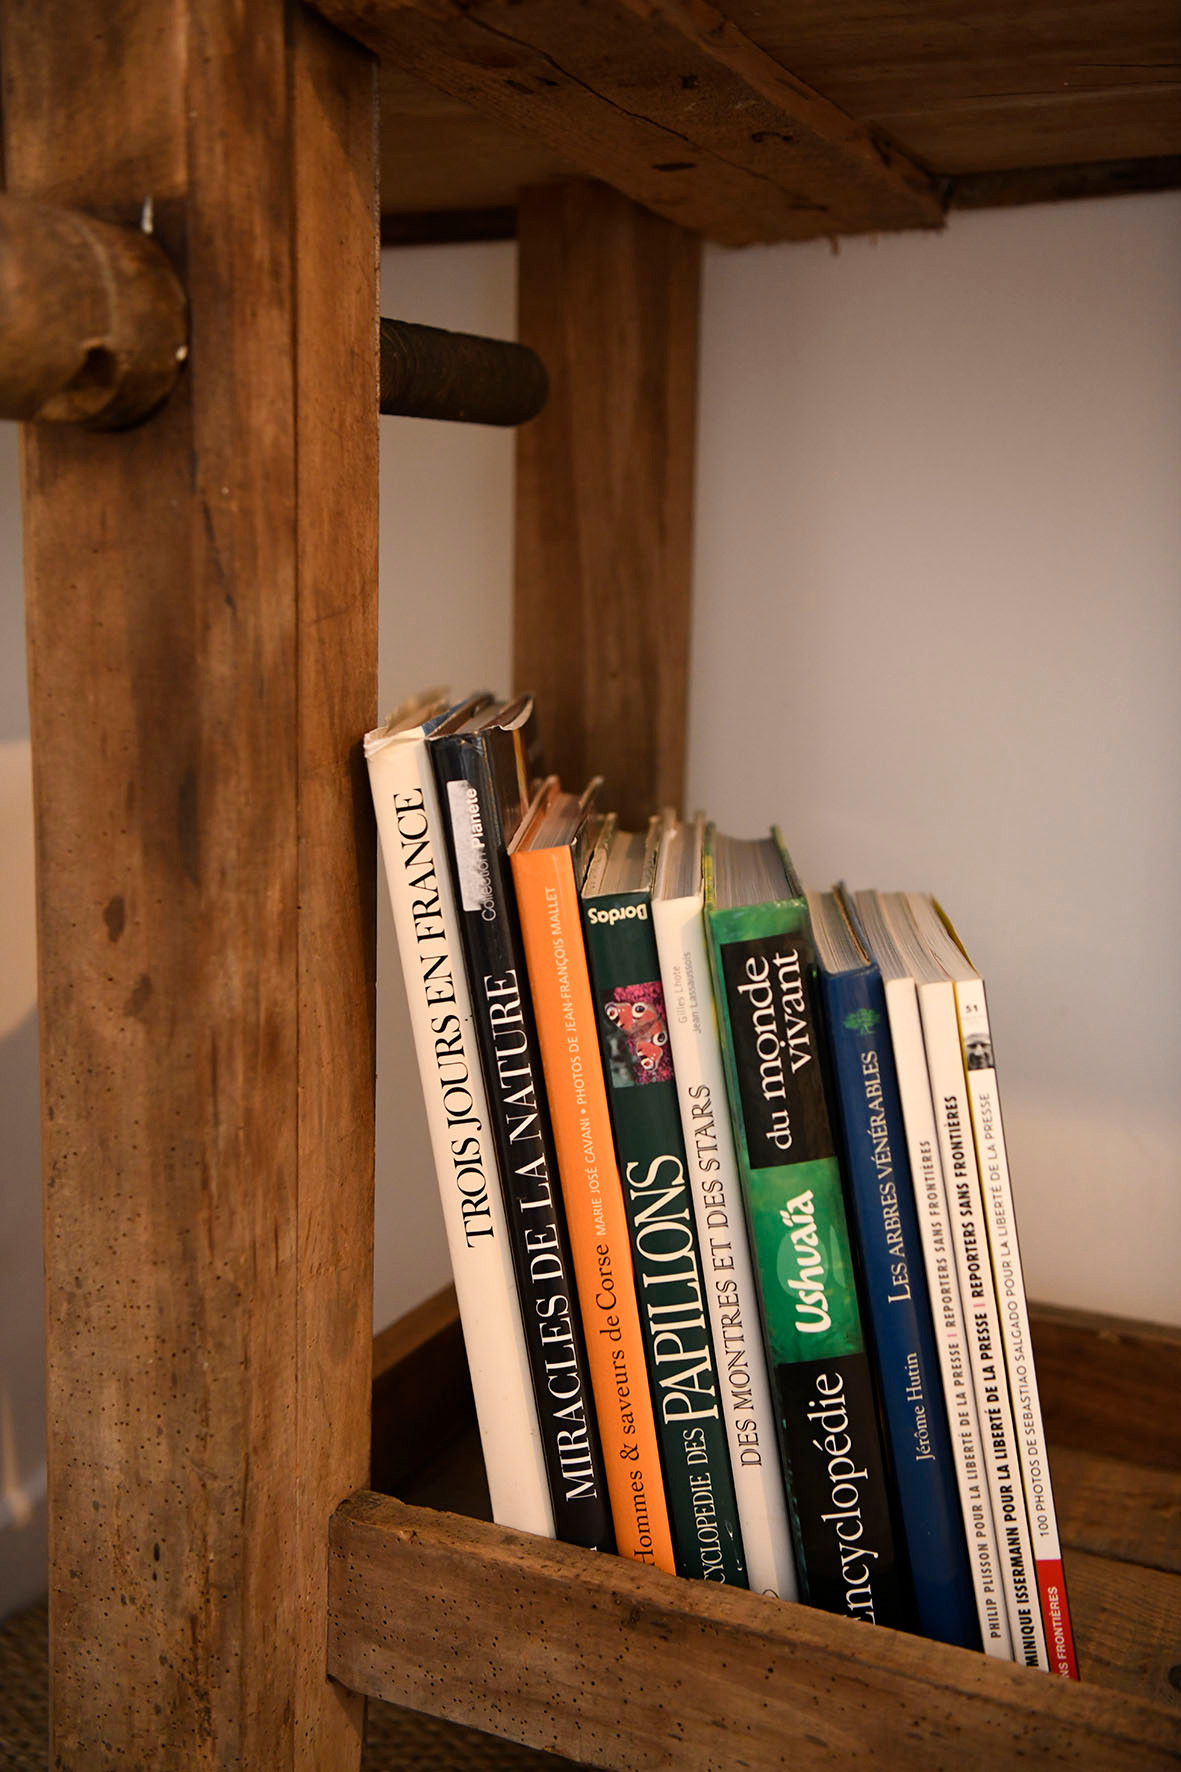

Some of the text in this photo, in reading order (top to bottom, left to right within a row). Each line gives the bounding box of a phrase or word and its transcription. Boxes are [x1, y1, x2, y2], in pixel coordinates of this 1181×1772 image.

[544, 887, 564, 936] MALLET
[587, 903, 649, 925] Bordas
[551, 937, 578, 1034] JEAN-FRANÇOIS
[772, 948, 812, 1074] vivant
[393, 788, 494, 1248] TROIS JOURS EN FRANCE
[567, 1035, 581, 1054] DE
[570, 1055, 586, 1105] PHOTOS
[738, 955, 793, 1150] du monde
[580, 1118, 597, 1164] CAVANI
[943, 1095, 968, 1178] FRONTIÈRES
[585, 1166, 600, 1196] JOSÉ
[860, 1050, 912, 1304] LES ARBRES VÉNÉRABLES
[956, 1183, 973, 1217] SANS
[483, 968, 597, 1502] MIRACLES DE LA NATURE
[591, 1197, 607, 1236] MARIE
[596, 1243, 620, 1311] Corse
[625, 1154, 719, 1425] PAPILLONS
[688, 1084, 762, 1467] DES MONTRES ET DES STARS
[961, 1221, 985, 1299] REPORTERS
[599, 1314, 623, 1342] de
[974, 1312, 993, 1361] PRESSE
[978, 1093, 1050, 1537] 100 PHOTOS DE SEBASTIAO SALGADO POUR LA LIBERTÉ DE LA PRESSE
[610, 1349, 636, 1436] saveurs
[919, 1140, 1001, 1639] PHILIP PLISSON POUR LA LIBERTÉ DE LA PRESSE REPORTERS SANS FRONTIÈRES
[982, 1364, 997, 1381] LA
[985, 1385, 1000, 1403] DE
[905, 1352, 936, 1461] Jérôme Hutin
[983, 1407, 1008, 1460] LIBERTÉ
[619, 1443, 640, 1460] &
[682, 1427, 709, 1466] DES
[997, 1464, 1011, 1480] LA
[1000, 1484, 1018, 1522] POUR
[1006, 1527, 1030, 1605] ISSERMANN
[1047, 1586, 1068, 1660] FRONTIÈRES
